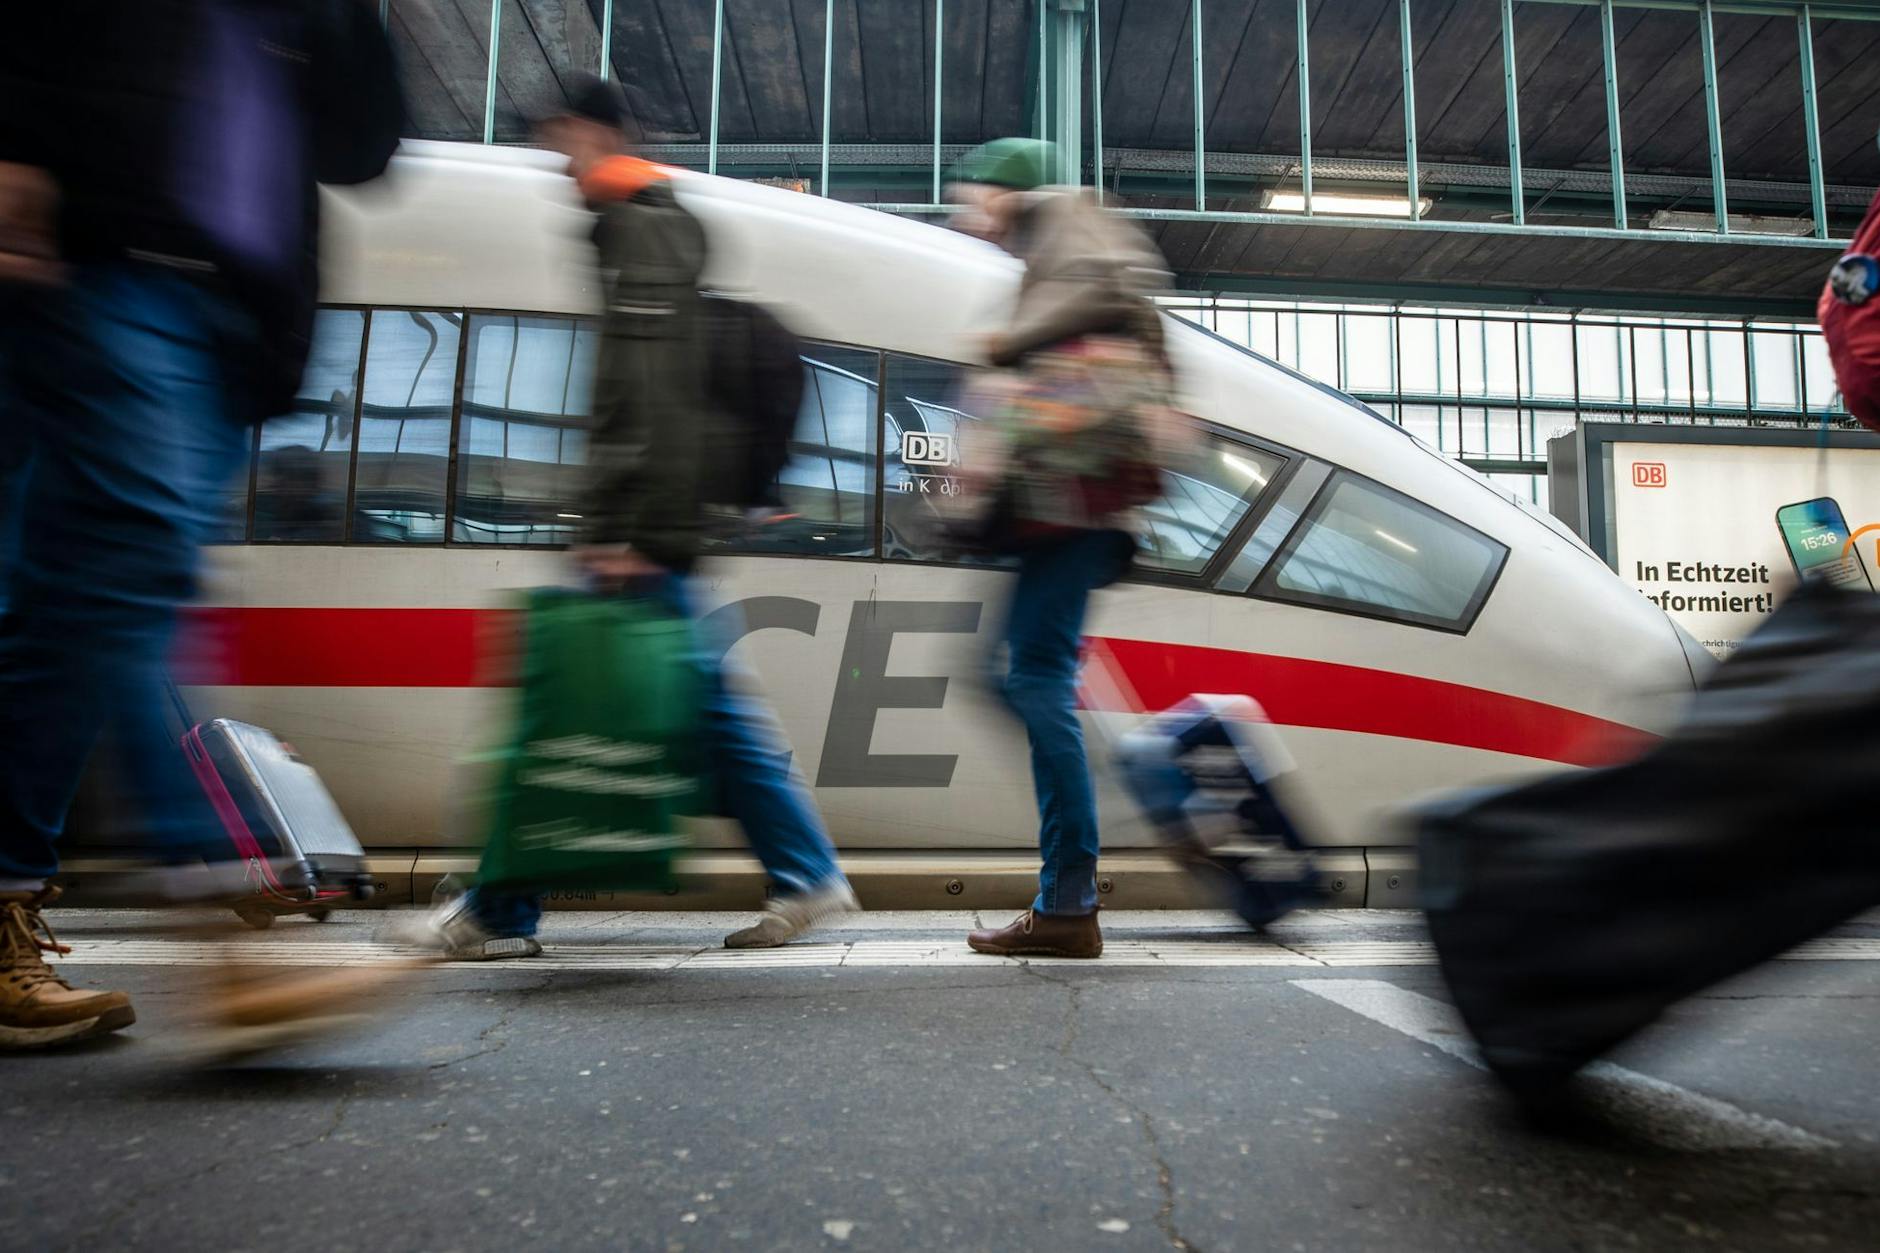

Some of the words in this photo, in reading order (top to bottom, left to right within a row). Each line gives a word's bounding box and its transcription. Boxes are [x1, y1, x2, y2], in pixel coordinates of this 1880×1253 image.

[906, 436, 947, 461] DB
[1636, 466, 1663, 484] DB
[1801, 532, 1837, 551] 15:26
[1637, 561, 1659, 581] In
[1667, 562, 1769, 583] Echtzeit
[1638, 589, 1773, 613] formiert!
[694, 595, 984, 788] CE
